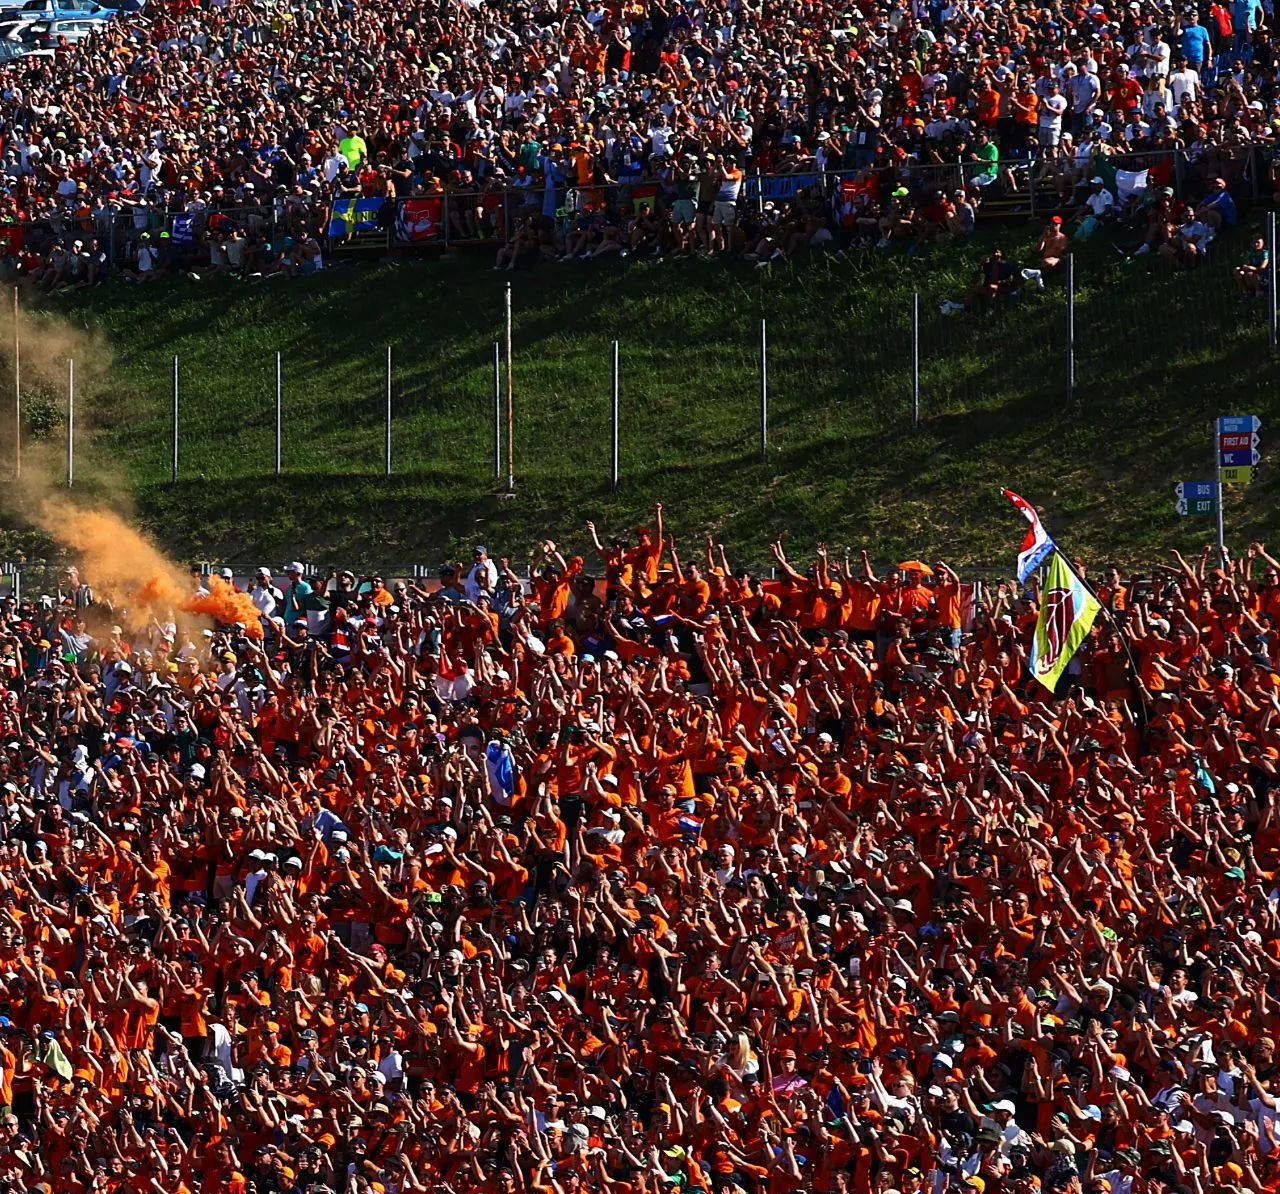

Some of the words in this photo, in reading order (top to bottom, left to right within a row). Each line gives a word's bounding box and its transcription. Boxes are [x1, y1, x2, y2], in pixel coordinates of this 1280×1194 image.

[1224, 437, 1238, 446] FIRST
[1239, 437, 1249, 446] AID
[1224, 454, 1234, 463] WC
[1225, 470, 1238, 479] TAXI
[1197, 485, 1210, 495] BUS
[1197, 501, 1211, 511] EXIT
